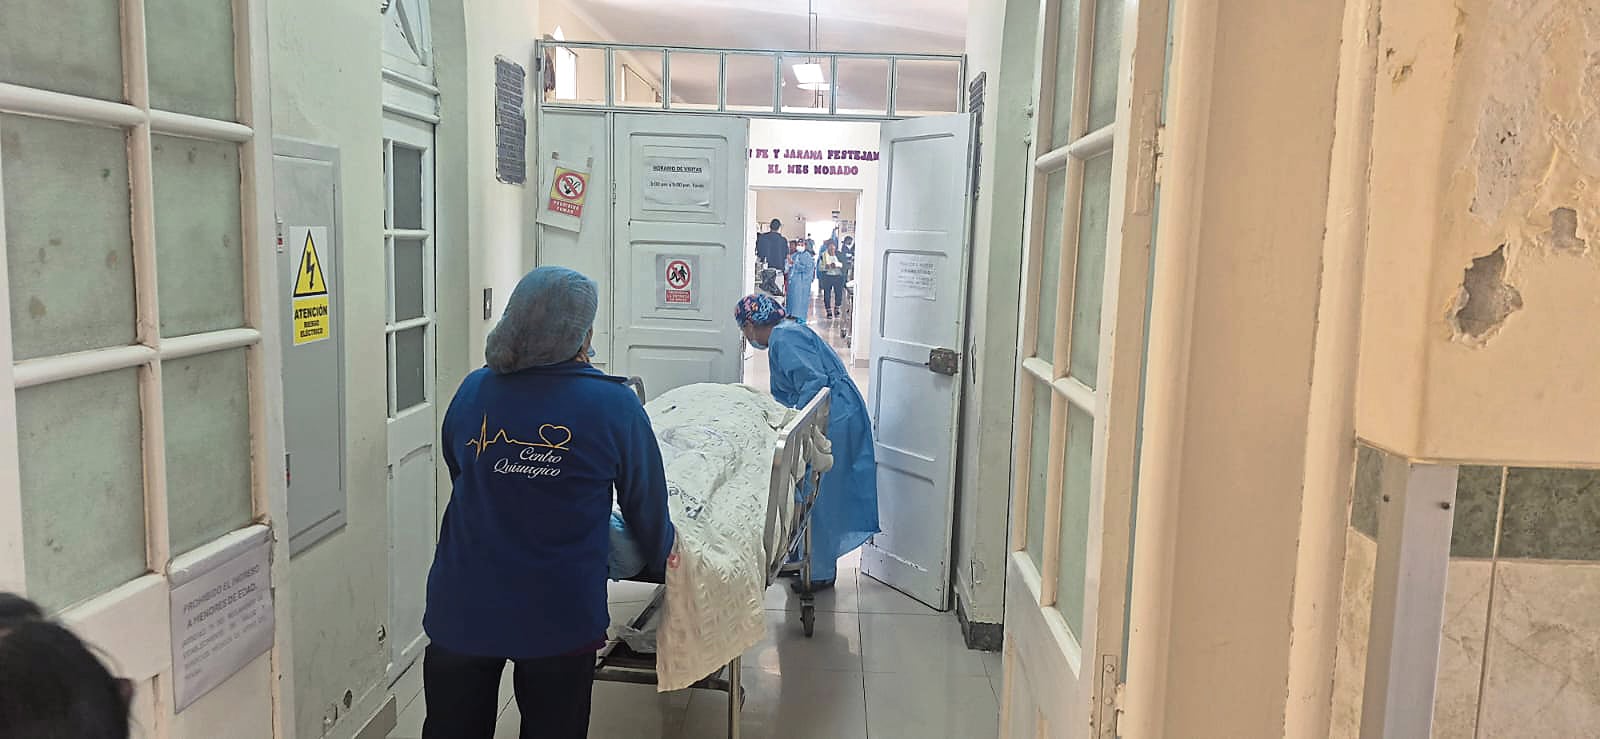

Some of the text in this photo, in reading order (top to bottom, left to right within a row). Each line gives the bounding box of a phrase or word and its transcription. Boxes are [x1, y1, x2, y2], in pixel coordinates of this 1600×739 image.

[755, 149, 768, 158] FE
[773, 149, 780, 158] Y
[784, 149, 823, 160] JARANA
[768, 164, 859, 175] EL MES MORADO
[294, 304, 328, 320] ATENCIÓN
[519, 446, 562, 463] Centro
[184, 584, 222, 615] PROHIBIDO
[192, 598, 228, 625] MENORES
